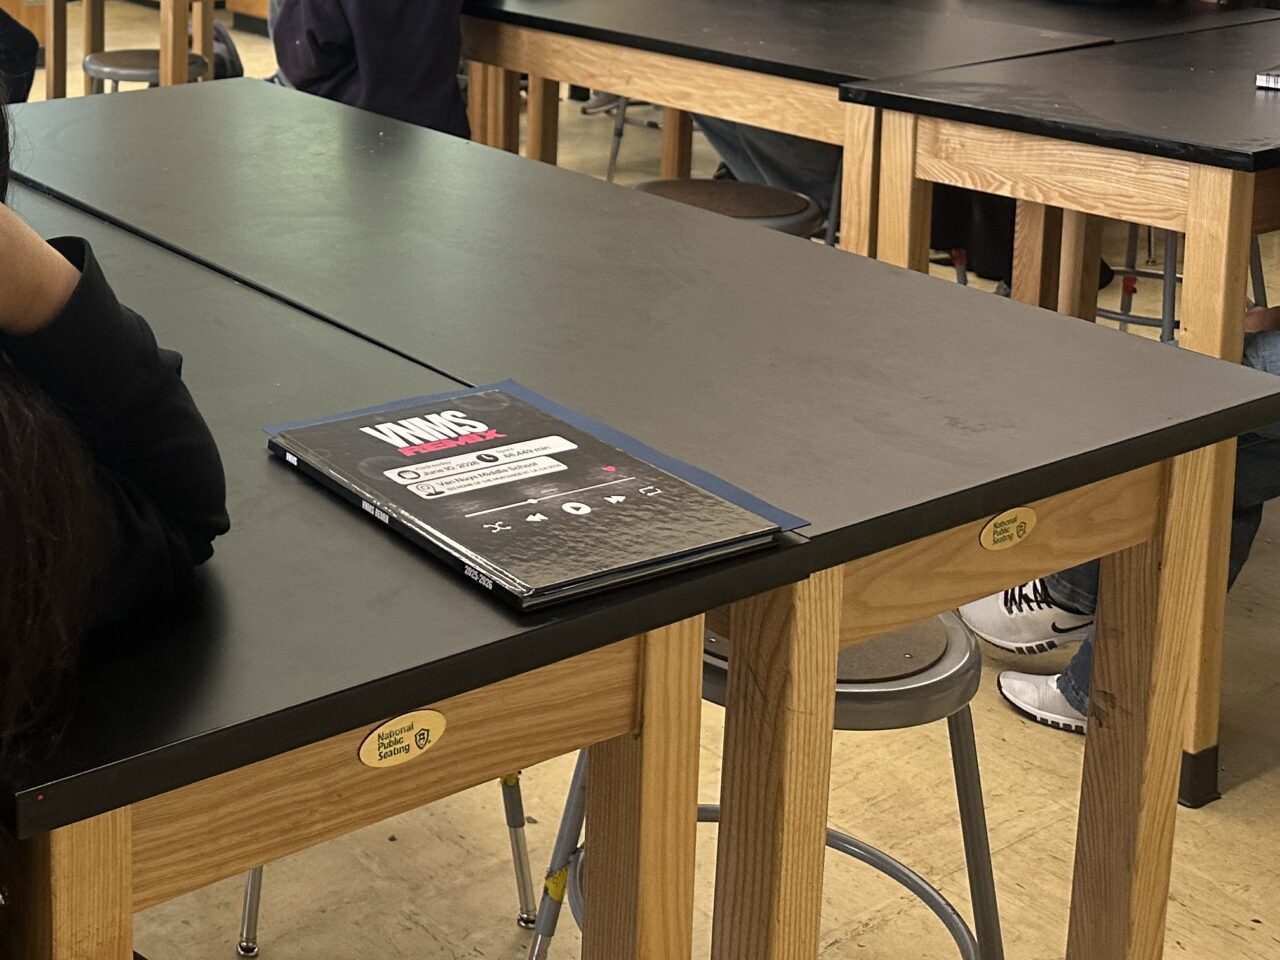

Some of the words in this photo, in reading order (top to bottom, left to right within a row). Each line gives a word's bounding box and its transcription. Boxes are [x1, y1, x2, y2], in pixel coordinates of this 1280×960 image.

[359, 410, 489, 448] VNMS
[397, 428, 507, 457] REMIX
[423, 468, 445, 476] June
[464, 564, 493, 590] 2025-2026
[377, 722, 414, 742] National
[377, 736, 405, 751] Public
[377, 744, 411, 761] Seating
